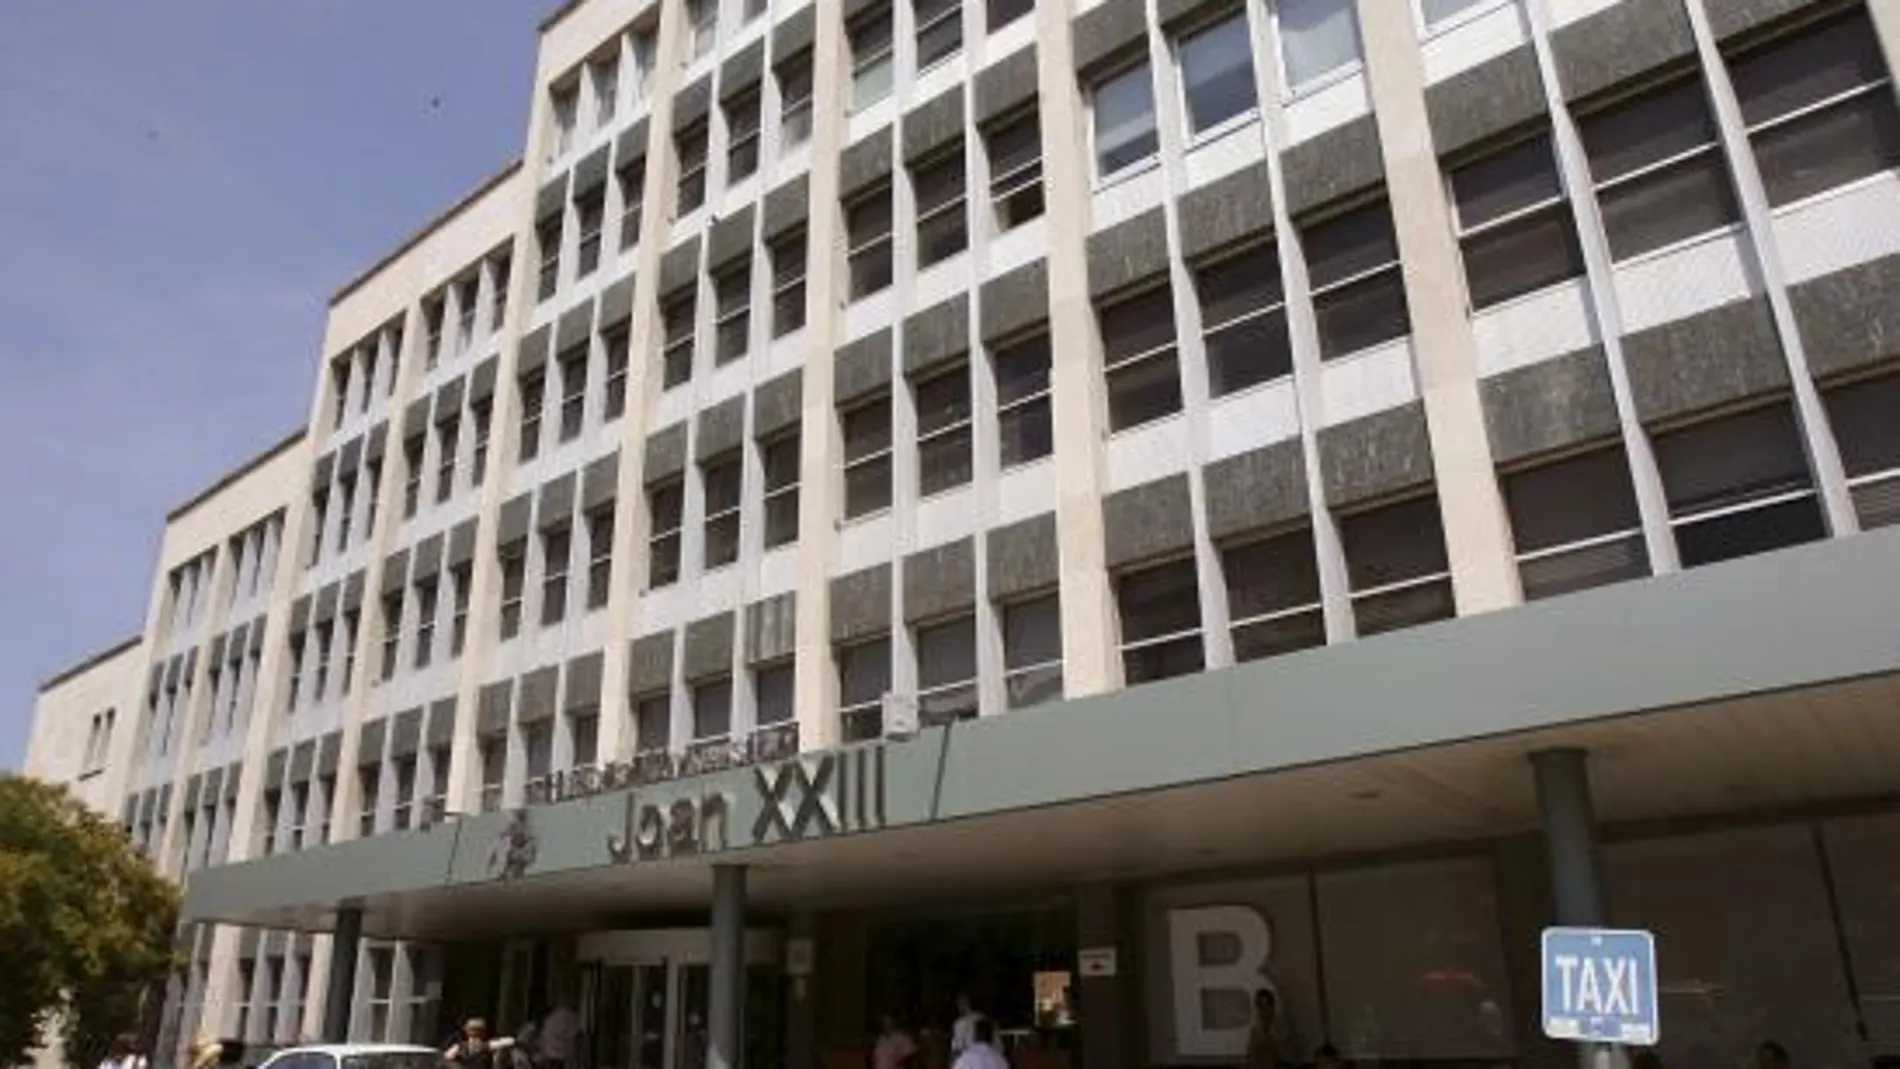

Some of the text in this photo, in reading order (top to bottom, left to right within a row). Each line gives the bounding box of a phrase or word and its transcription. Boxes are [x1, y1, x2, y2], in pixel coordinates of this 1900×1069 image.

[608, 790, 731, 863] Joan
[752, 745, 887, 847] XXIII
[1167, 904, 1279, 1056] B
[1555, 955, 1640, 1016] TAXI
